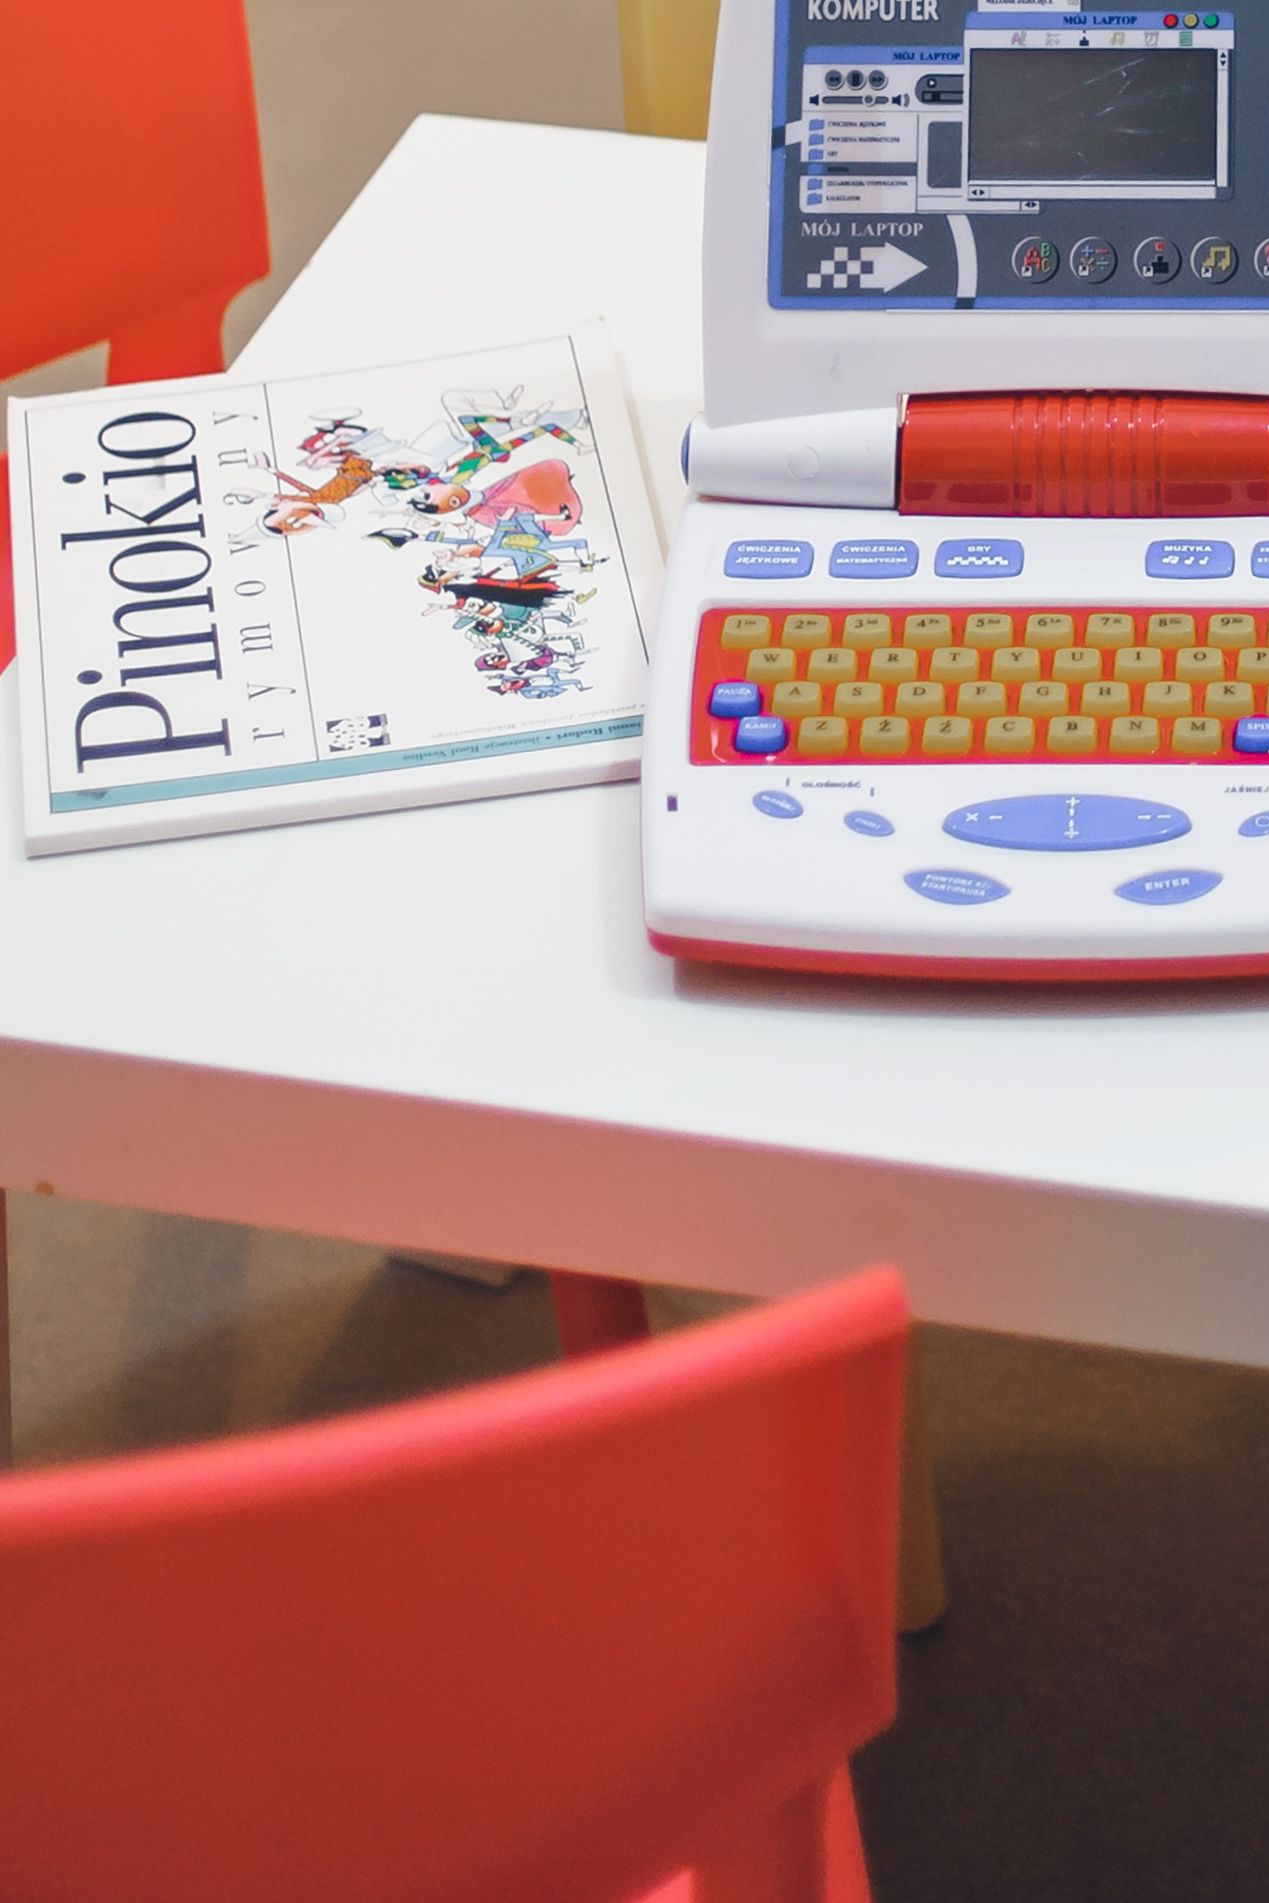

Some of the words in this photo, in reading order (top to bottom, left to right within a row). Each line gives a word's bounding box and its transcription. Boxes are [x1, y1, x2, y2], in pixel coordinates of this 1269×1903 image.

[1063, 14, 1087, 25] MÓJ
[1093, 16, 1137, 26] LAPTOP
[893, 51, 915, 60] MÓJ
[920, 53, 961, 61] LAPTOP
[801, 219, 840, 237] MÓJ
[851, 223, 923, 236] LAPTOP
[738, 544, 801, 553] ĆWICZENIA
[842, 544, 905, 553] ĆWICZENIA
[735, 557, 798, 566] JĘZYKOWE
[61, 410, 231, 773] Pinokio
[736, 619, 743, 628] 1
[795, 620, 804, 628] 2
[855, 619, 864, 628] 3
[916, 619, 926, 628] 4
[976, 618, 985, 627] 5
[1037, 618, 1048, 627] 6
[1101, 617, 1110, 626] 7
[1158, 618, 1168, 627] 8
[1220, 617, 1230, 627] 9
[763, 654, 780, 663] W
[827, 653, 839, 663] E
[887, 653, 899, 663] R
[949, 652, 961, 661] T
[1011, 652, 1023, 662] Y
[1071, 652, 1084, 661] U
[1135, 652, 1141, 660] I
[1193, 652, 1207, 661] O
[1256, 652, 1267, 661] P
[789, 687, 801, 696] A
[852, 687, 862, 696] S
[913, 687, 926, 696] D
[975, 687, 987, 696] F
[1036, 686, 1050, 696] G
[1098, 687, 1112, 696] H
[1164, 685, 1172, 695] J
[1223, 686, 1236, 695] K
[816, 720, 828, 730] Z
[1002, 721, 1015, 731] C
[1067, 721, 1078, 731] B
[1129, 721, 1143, 731] N
[1191, 722, 1206, 731] M
[1224, 784, 1269, 793] JAŚNIEJ
[1144, 876, 1191, 891] ENTER
